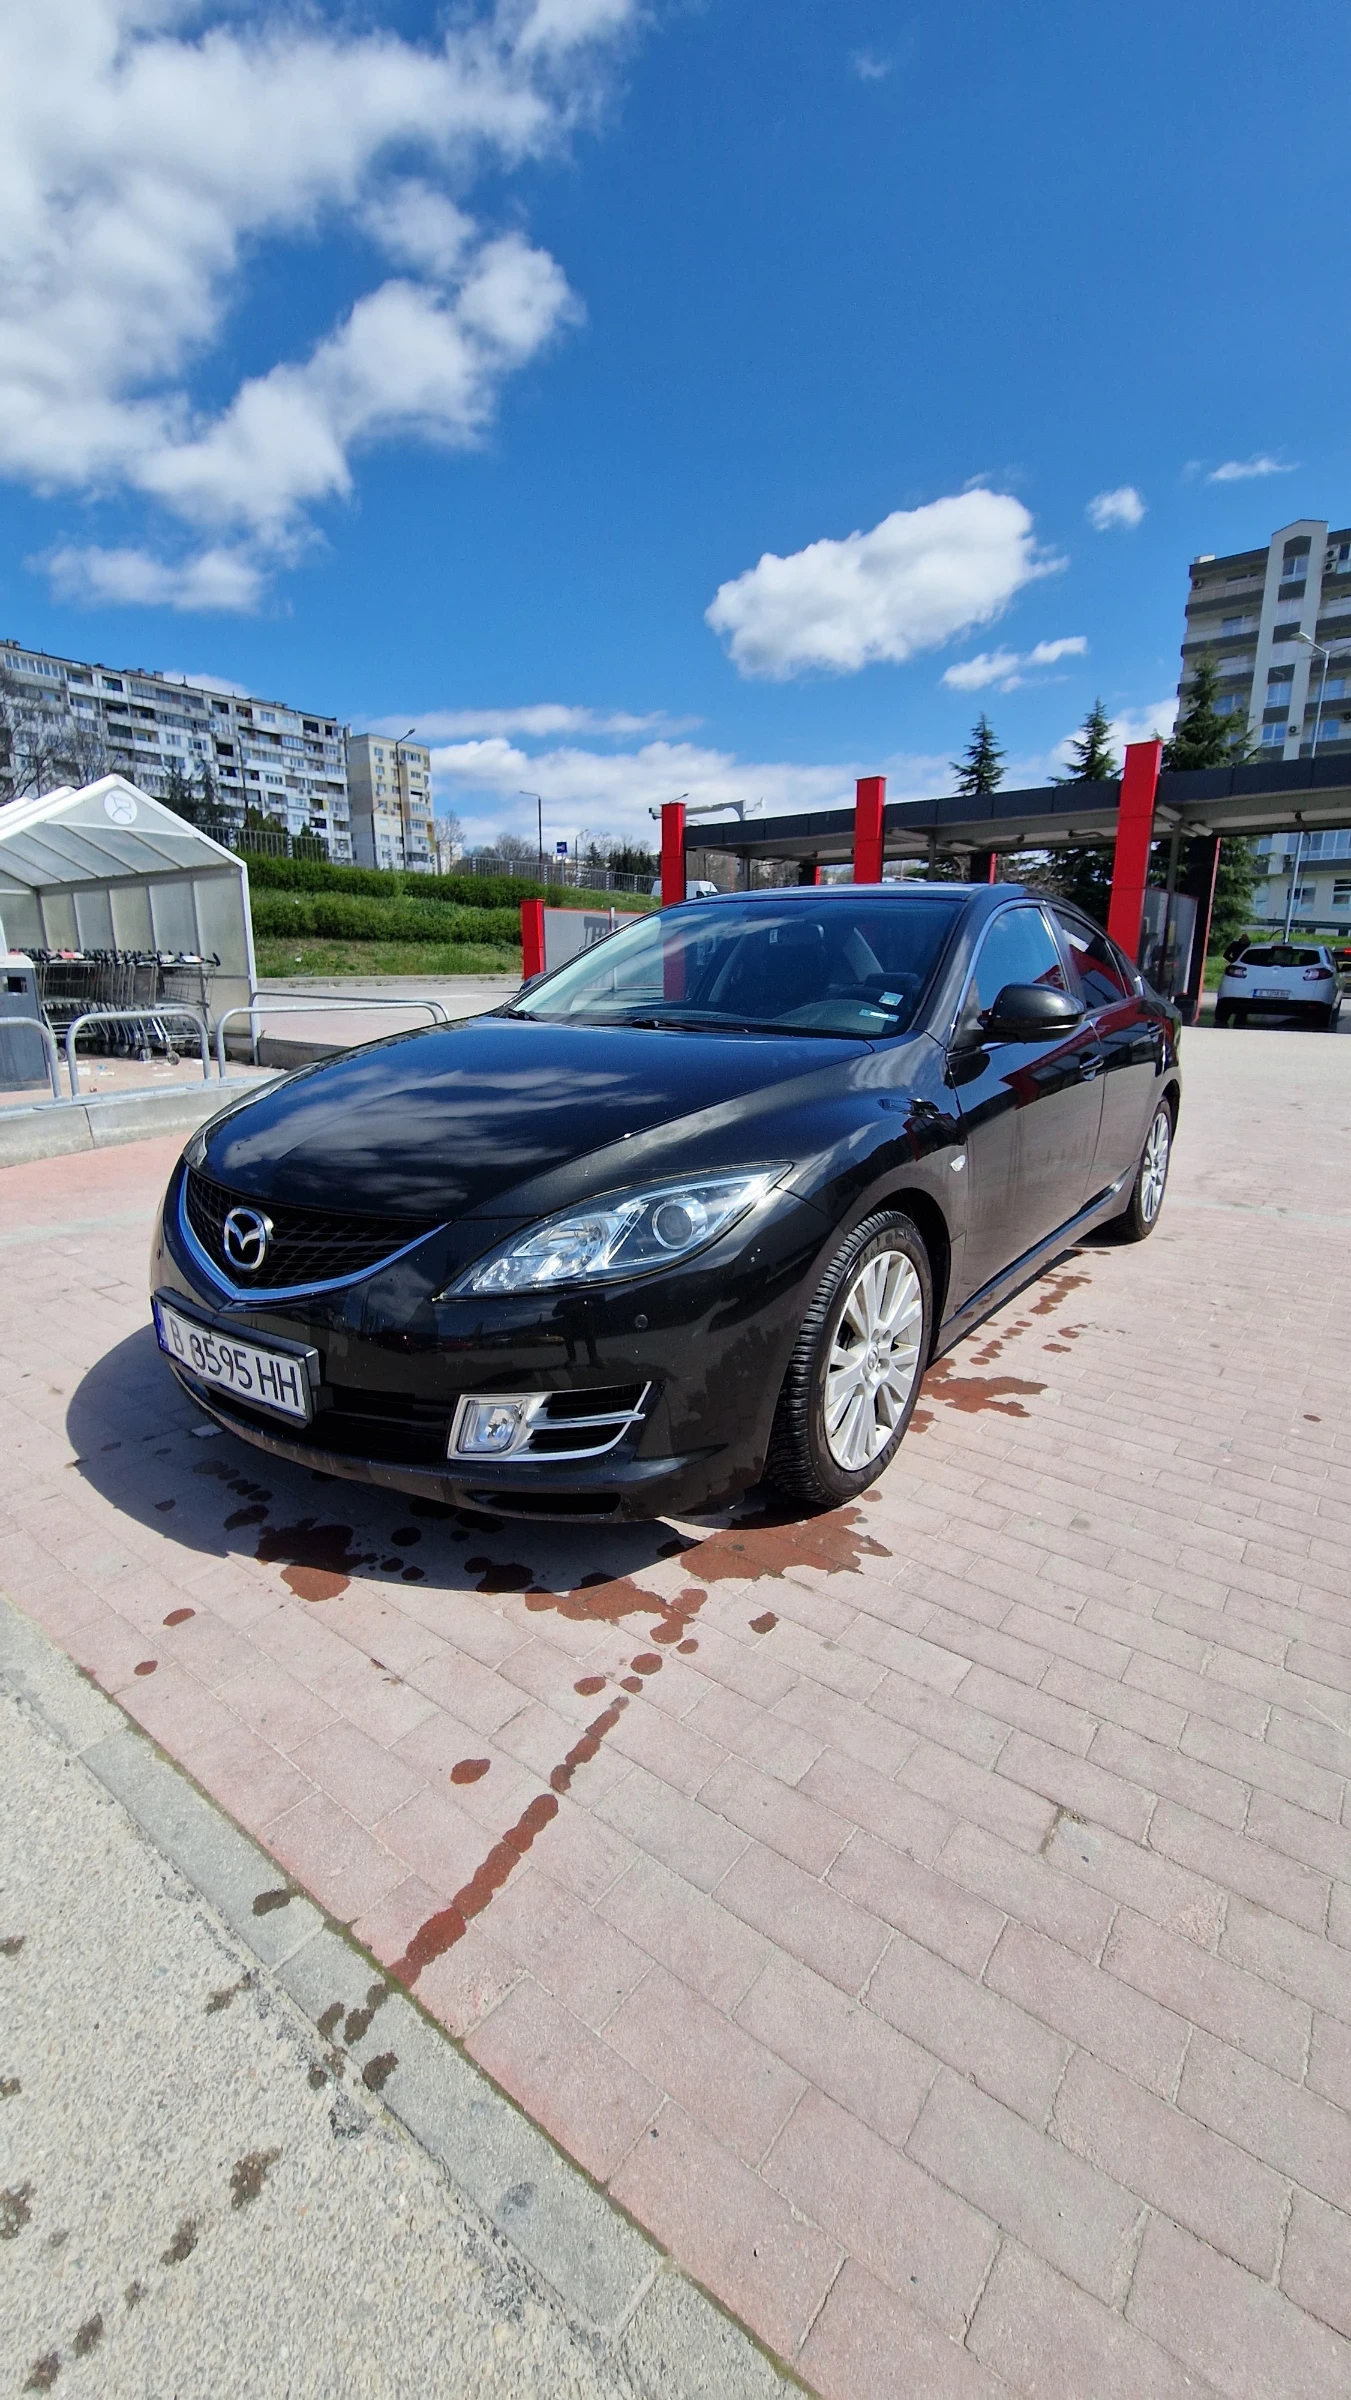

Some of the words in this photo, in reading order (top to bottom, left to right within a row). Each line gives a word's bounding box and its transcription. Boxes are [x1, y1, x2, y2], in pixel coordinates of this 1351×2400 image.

[169, 1316, 184, 1356] B
[189, 1333, 253, 1390] 8595
[255, 1356, 300, 1407] HH
